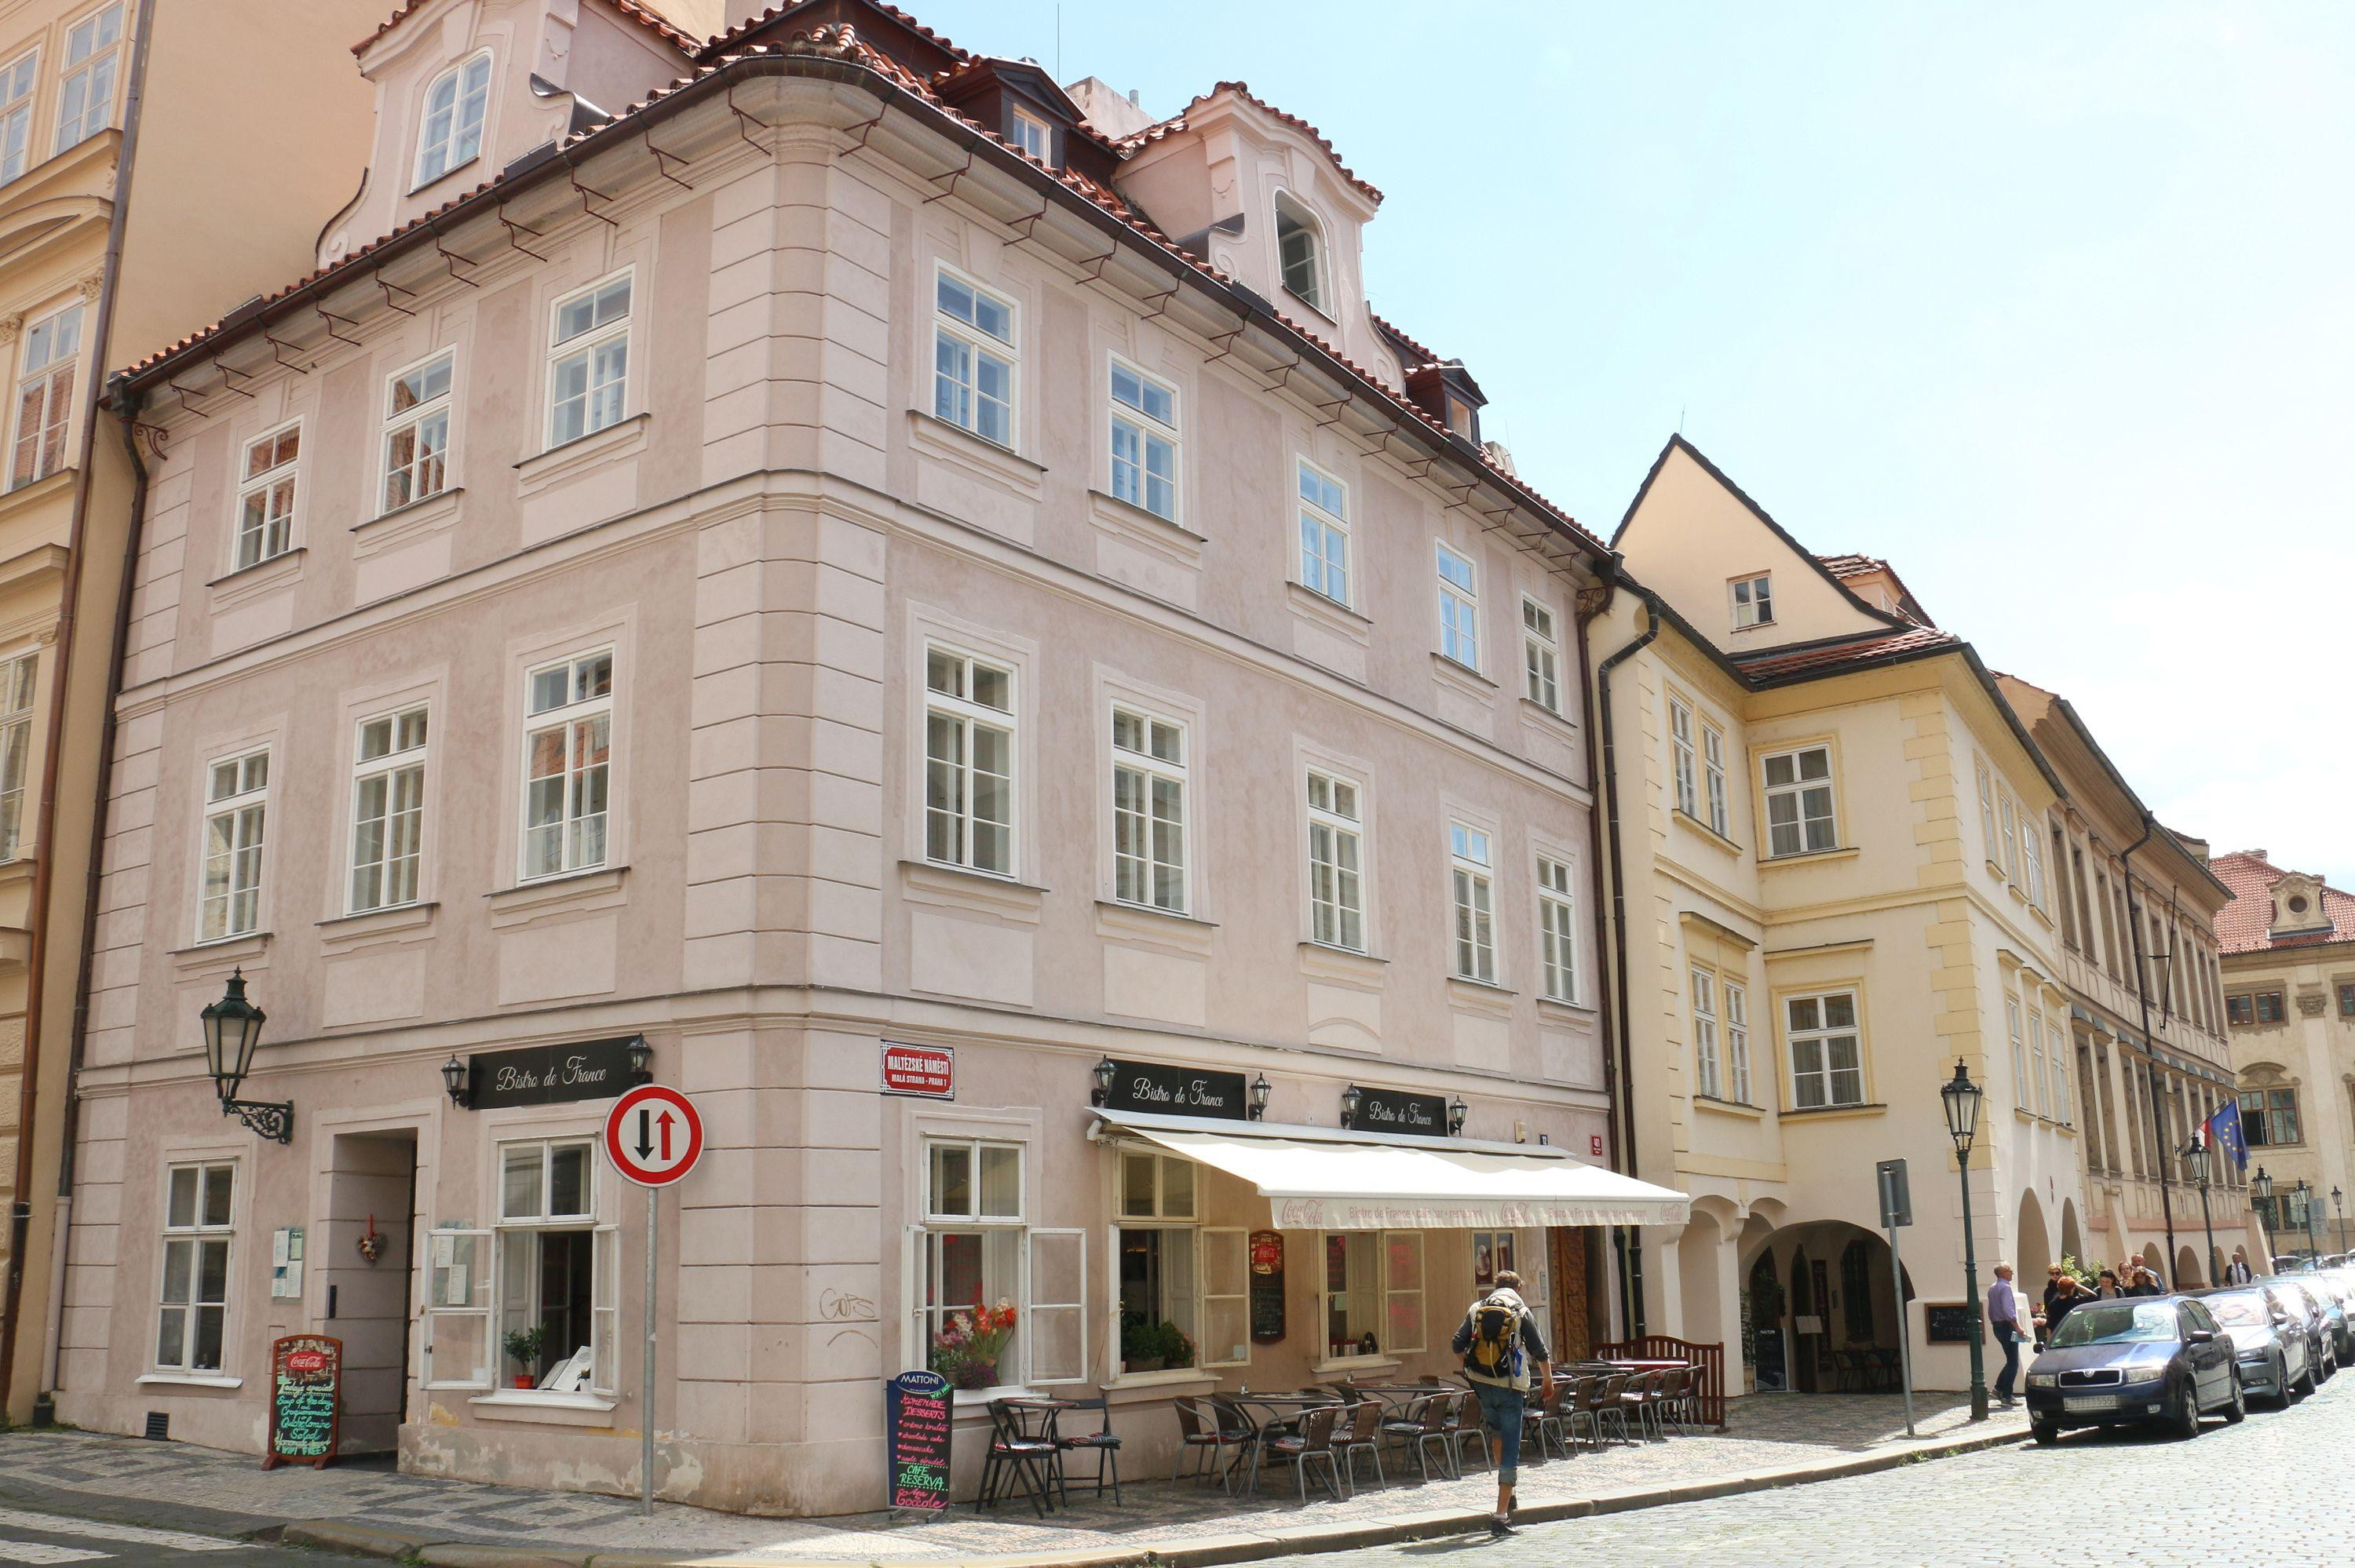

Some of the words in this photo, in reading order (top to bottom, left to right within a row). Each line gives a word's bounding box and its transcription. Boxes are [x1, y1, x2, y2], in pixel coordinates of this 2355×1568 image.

[888, 1054, 923, 1072] MALTÉZSKÉ
[924, 1056, 949, 1075] NÁMĚSTÍ
[496, 1067, 539, 1091] Bistro
[543, 1067, 557, 1086] de
[562, 1056, 607, 1085] France
[892, 1073, 906, 1083] MALÁ
[907, 1075, 926, 1085] STRANA
[928, 1077, 944, 1086] PRAHA
[1133, 1078, 1170, 1102] Bistro
[1174, 1087, 1185, 1103] de
[1189, 1080, 1223, 1107] France
[1369, 1101, 1396, 1121] Bistro
[1398, 1108, 1406, 1123] de
[1408, 1103, 1432, 1125] France
[1282, 1198, 1324, 1225] Coca-Cola
[1349, 1207, 1372, 1219] Bistro
[1375, 1207, 1384, 1219] de
[1386, 1207, 1411, 1219] France
[290, 1355, 322, 1369] Coca-Cola
[900, 1375, 939, 1384] MATTONI
[900, 1394, 946, 1409] HOMEMADE
[904, 1406, 946, 1420] DESSERTS
[907, 1465, 930, 1476] CAFE
[899, 1473, 944, 1490] RESERVA
